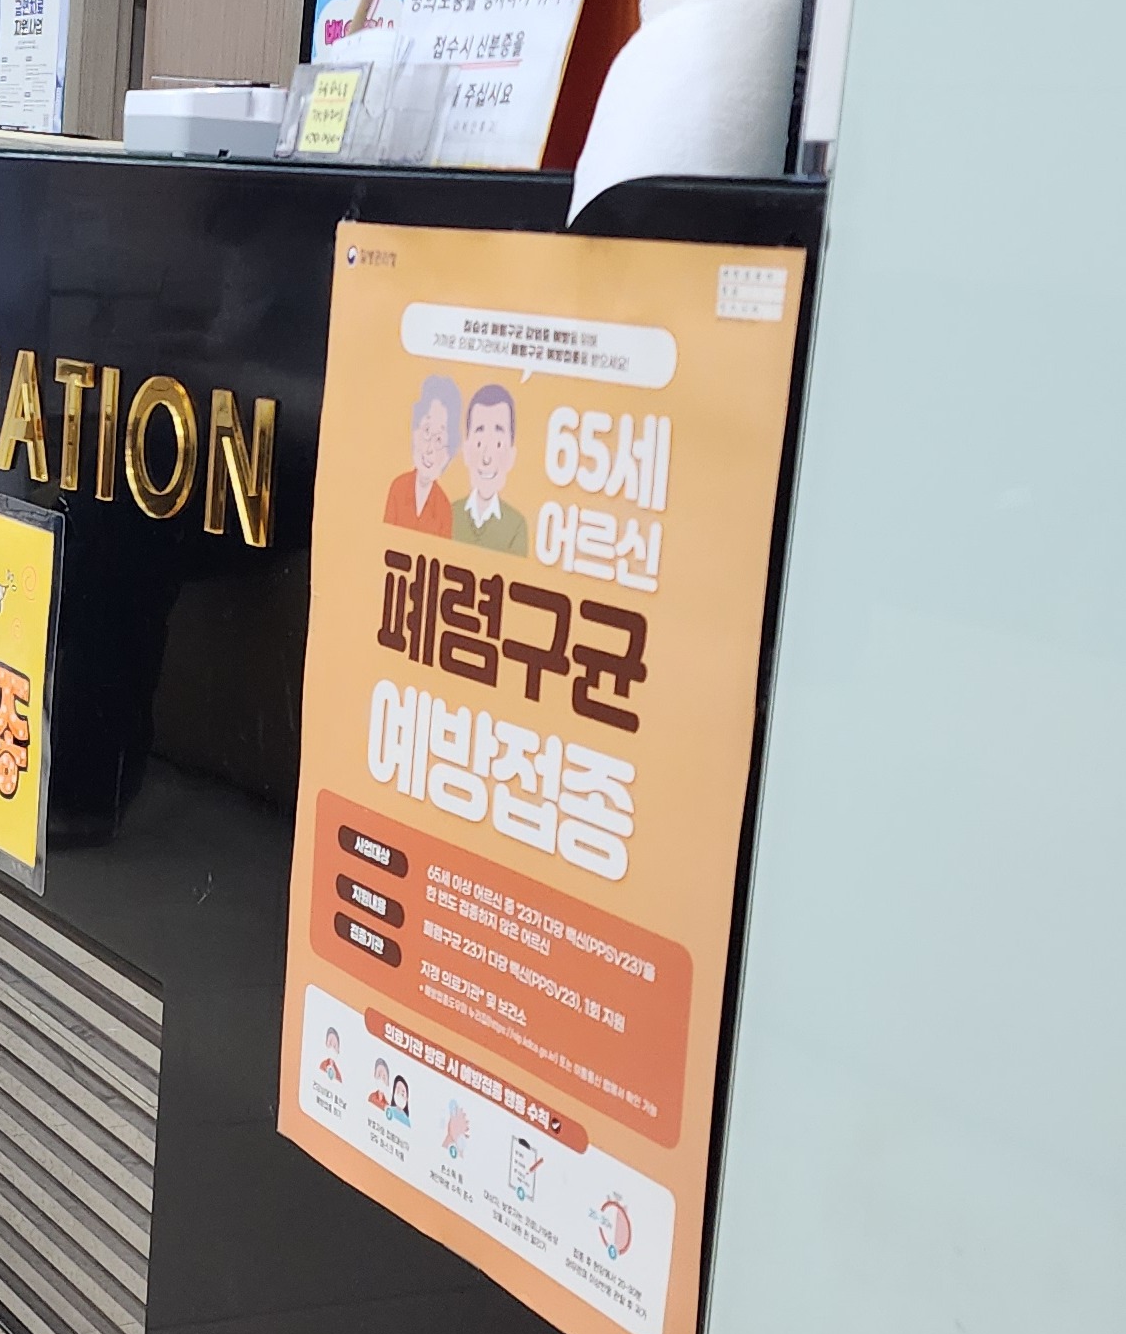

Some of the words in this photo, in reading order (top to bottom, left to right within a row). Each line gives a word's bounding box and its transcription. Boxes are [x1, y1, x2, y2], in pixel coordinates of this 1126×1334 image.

[544, 405, 672, 512] 65세
[534, 500, 663, 593] 어르신
[377, 548, 648, 734] 폐렴구균
[367, 678, 636, 882] 예방접종
[354, 834, 390, 867] 사업대상
[349, 922, 384, 956] 접종기관
[425, 882, 437, 903] 한
[437, 888, 458, 913] 번도
[458, 896, 498, 932] 접종하지
[498, 915, 519, 942] 않은
[519, 925, 551, 957] 어르신
[427, 861, 451, 888] 65세
[451, 872, 472, 898] 이상
[472, 881, 503, 911] 어르신
[542, 913, 564, 940] 다당
[419, 958, 440, 984] 지정
[497, 996, 527, 1028] 보건소
[422, 917, 462, 952] 폐렴구균
[462, 936, 487, 964] 23가
[487, 948, 508, 974] 다당
[601, 1005, 625, 1034] 지원
[384, 1021, 423, 1060] 의료기관
[423, 1043, 446, 1072] 방문
[446, 1055, 458, 1079] 시
[458, 1062, 502, 1105] 예방접종
[526, 1101, 550, 1132] 수칙
